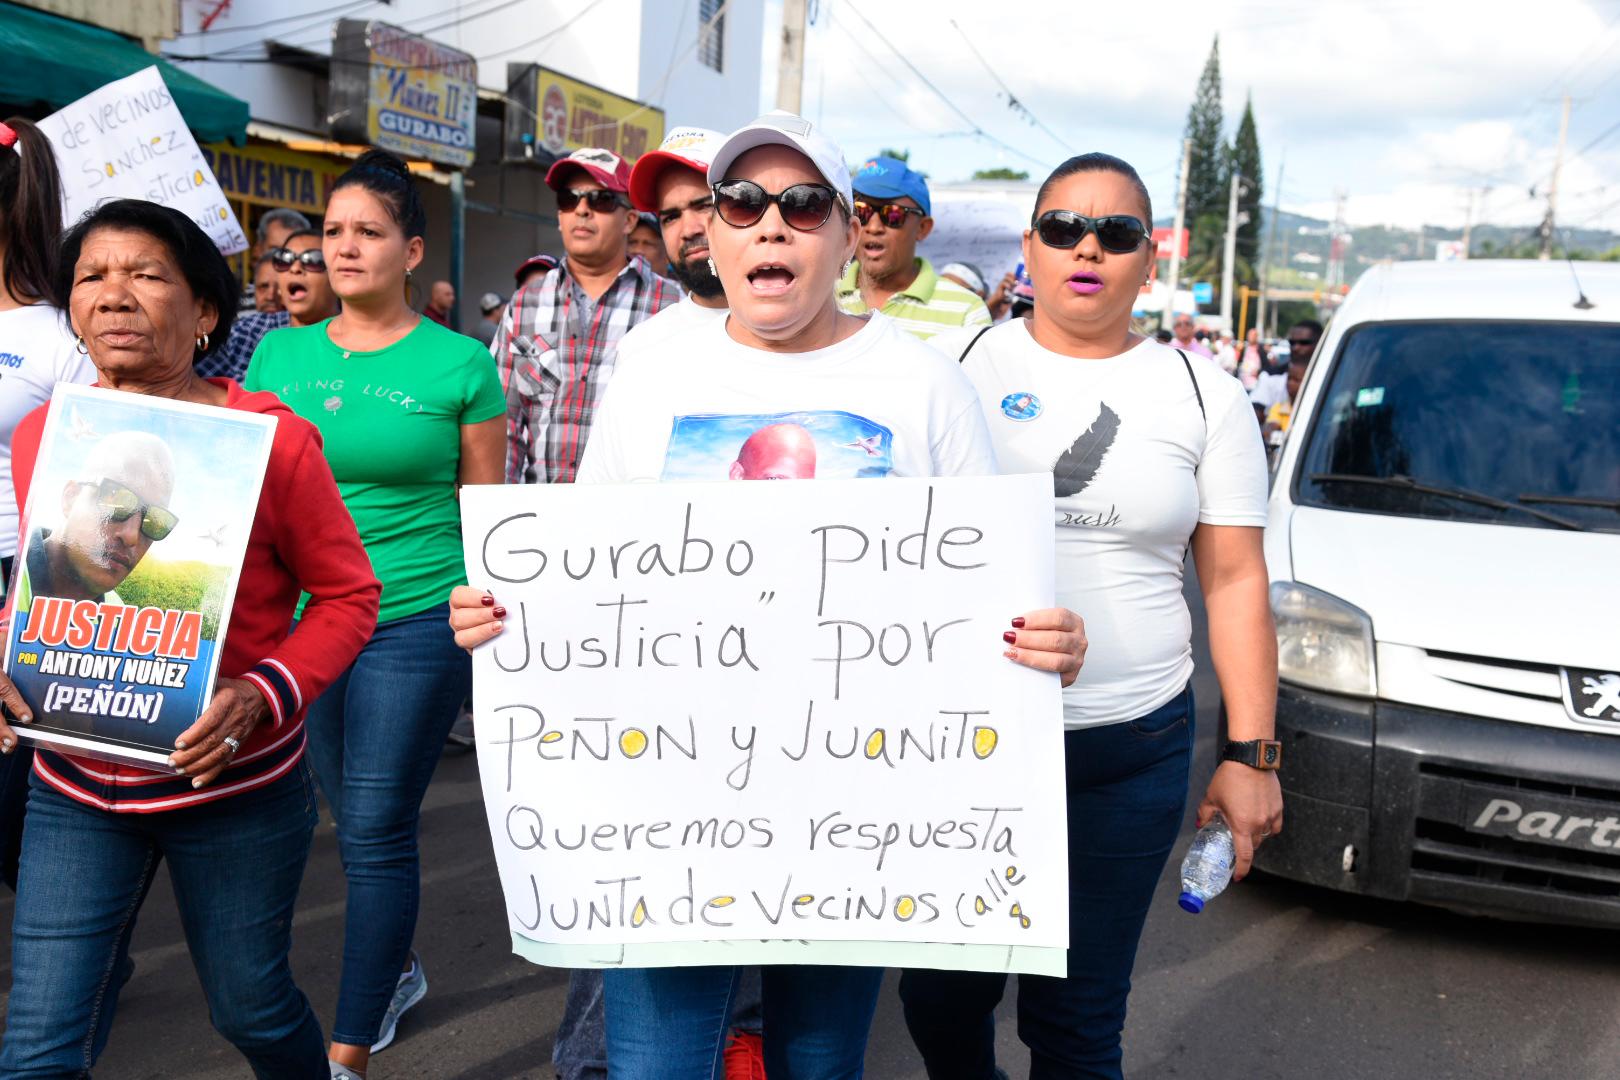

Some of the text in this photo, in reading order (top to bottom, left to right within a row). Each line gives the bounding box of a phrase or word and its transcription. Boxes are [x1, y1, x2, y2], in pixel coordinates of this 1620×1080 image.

[61, 113, 90, 150] de
[379, 110, 468, 147] GURABO
[481, 502, 754, 584] Gurabo
[20, 596, 203, 661] JUSTICIA
[17, 650, 189, 689] POR ANTONY NUÑEZ
[814, 613, 972, 700] por
[43, 681, 164, 724] (PEÑÓN)
[726, 725, 757, 792] y
[505, 804, 774, 852] Queremos
[668, 867, 737, 927] de
